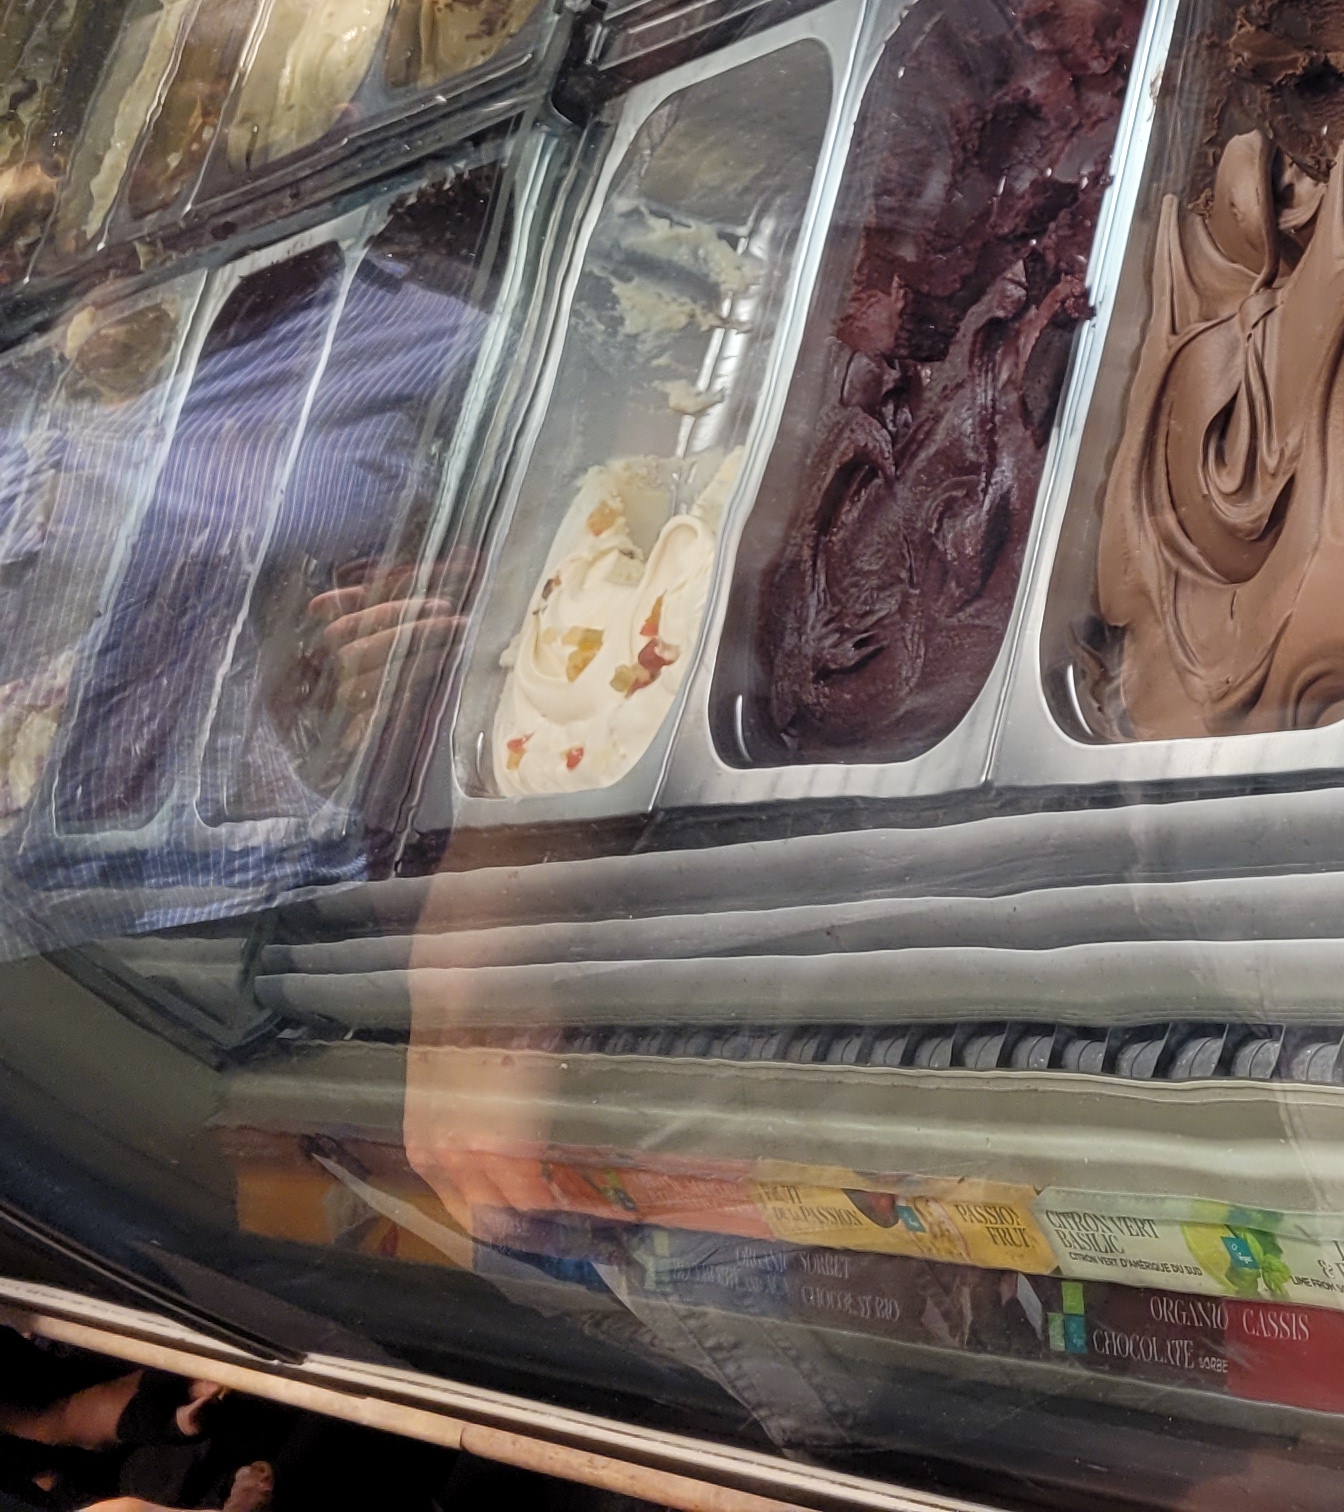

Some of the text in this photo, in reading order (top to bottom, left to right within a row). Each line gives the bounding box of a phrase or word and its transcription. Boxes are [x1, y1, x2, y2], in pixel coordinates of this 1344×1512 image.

[1045, 1210, 1160, 1239] CITRON VERT
[1054, 1228, 1125, 1255] BASILIC
[799, 1251, 850, 1279] SORBET
[1068, 1251, 1098, 1264] CITRON
[1099, 1256, 1118, 1267] VERT
[1171, 1263, 1185, 1275] DU
[1185, 1266, 1204, 1276] SUD
[1317, 1258, 1335, 1279] &
[1292, 1275, 1312, 1286] LIME
[1310, 1278, 1334, 1292] FROM
[1242, 1308, 1310, 1342] CASSIS
[1092, 1328, 1195, 1370] CHOCOLATE
[1198, 1356, 1229, 1374] SORBE
